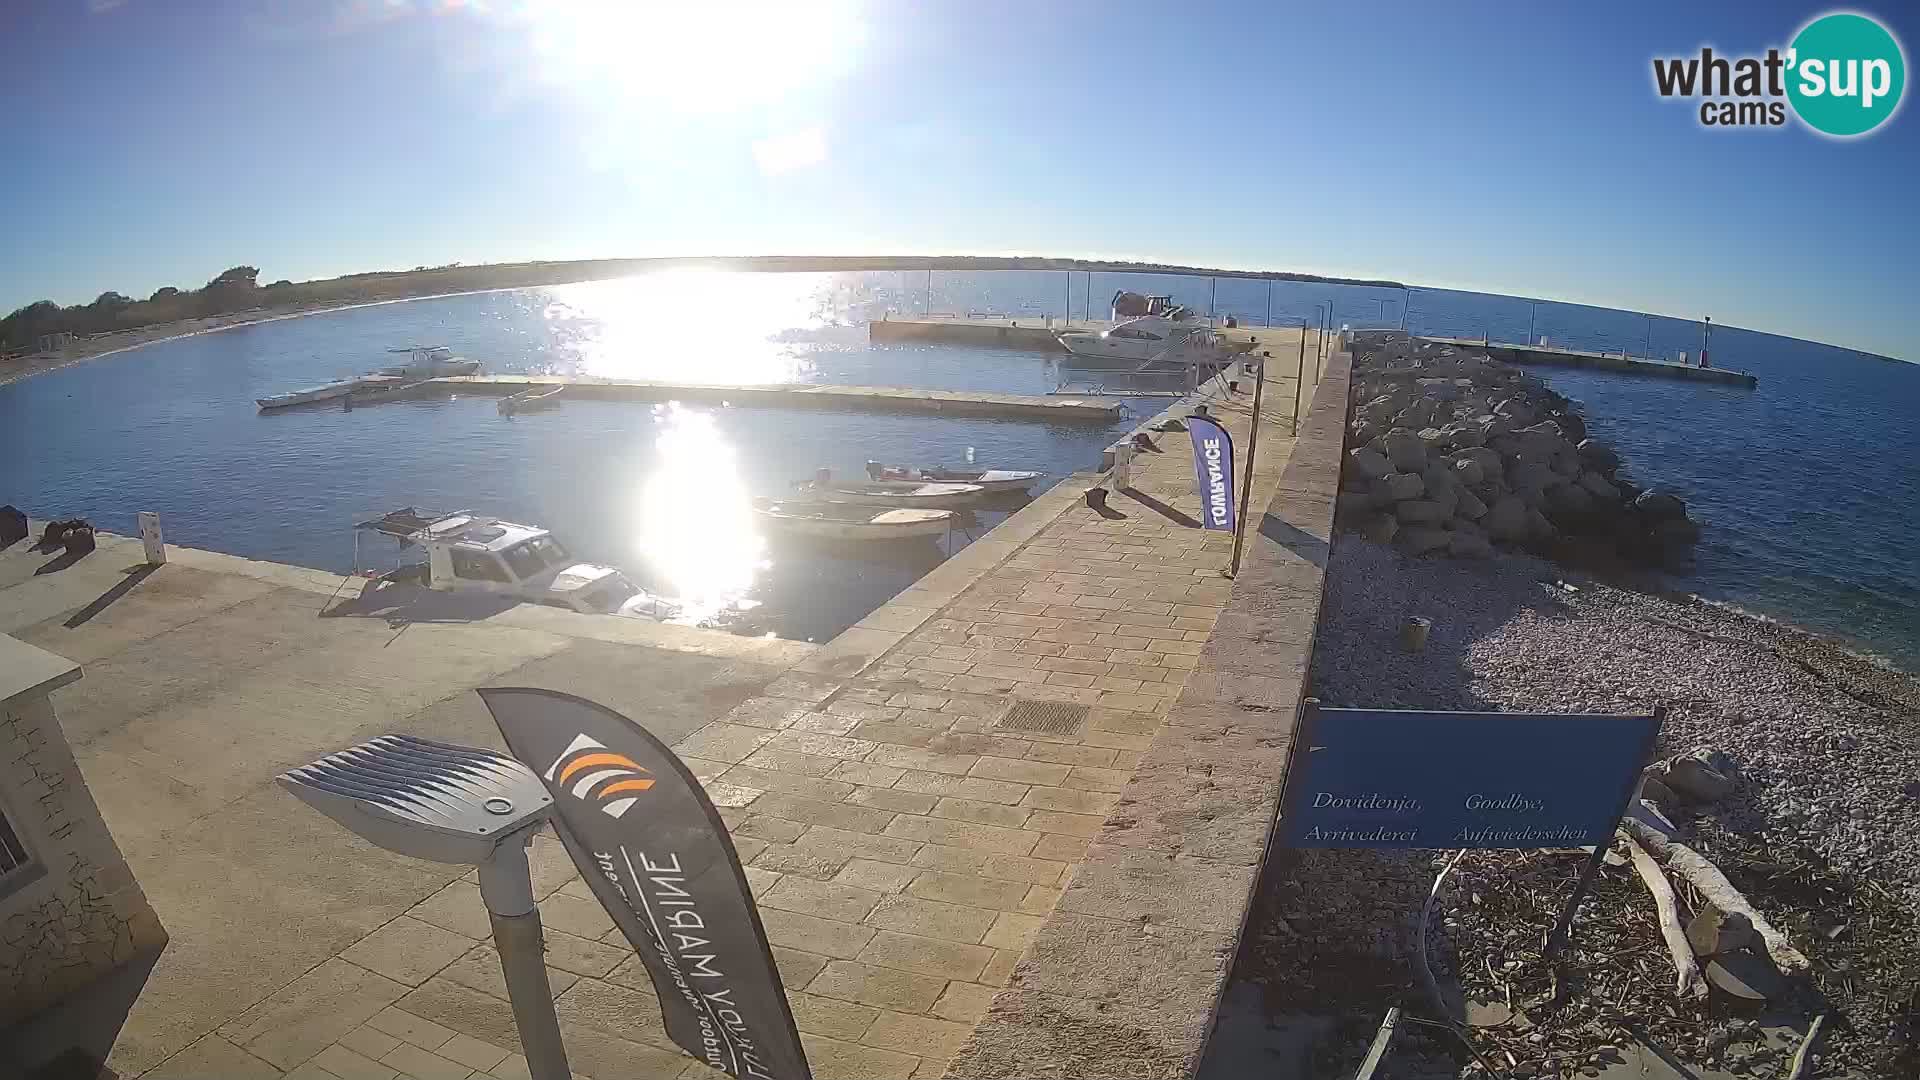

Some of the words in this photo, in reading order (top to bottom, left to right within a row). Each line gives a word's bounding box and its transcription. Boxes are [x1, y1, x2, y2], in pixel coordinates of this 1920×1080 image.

[1464, 793, 1544, 813] Goodbye,
[1303, 825, 1418, 841] Arrivederci
[1453, 825, 1588, 843] Aufwiedersehen
